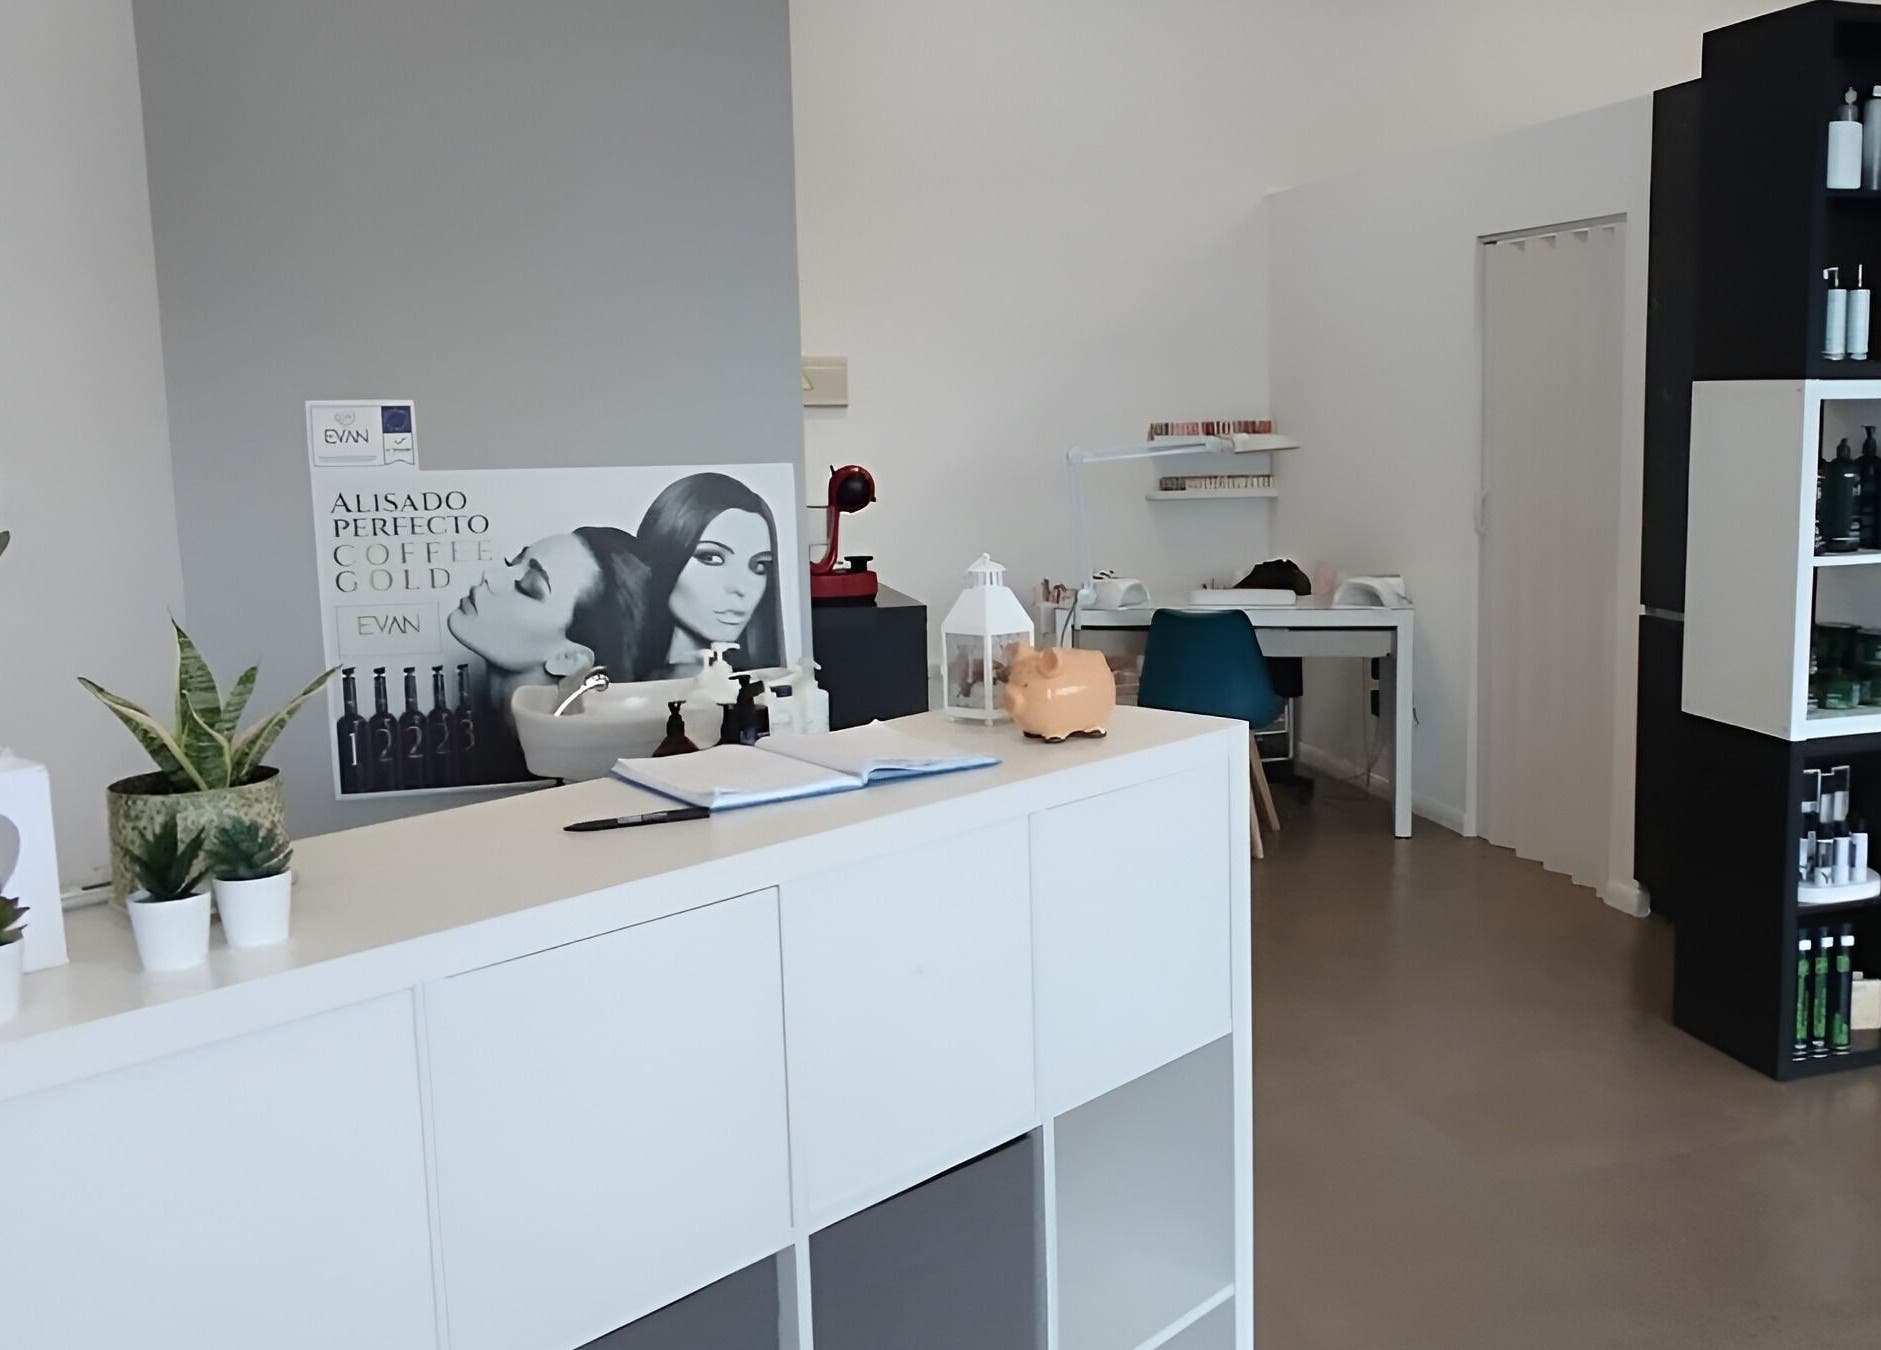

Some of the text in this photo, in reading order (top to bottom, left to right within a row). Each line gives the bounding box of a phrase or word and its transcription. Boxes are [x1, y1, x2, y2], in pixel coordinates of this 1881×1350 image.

[324, 428, 369, 444] EVAN
[331, 491, 467, 513] ALISADO
[333, 514, 489, 537] PERFECTO
[333, 540, 493, 567] COFFEE
[335, 568, 450, 593] GOLD
[357, 613, 421, 635] EVAN
[349, 732, 358, 766] 1
[375, 728, 393, 762] 2
[406, 725, 425, 758] 2
